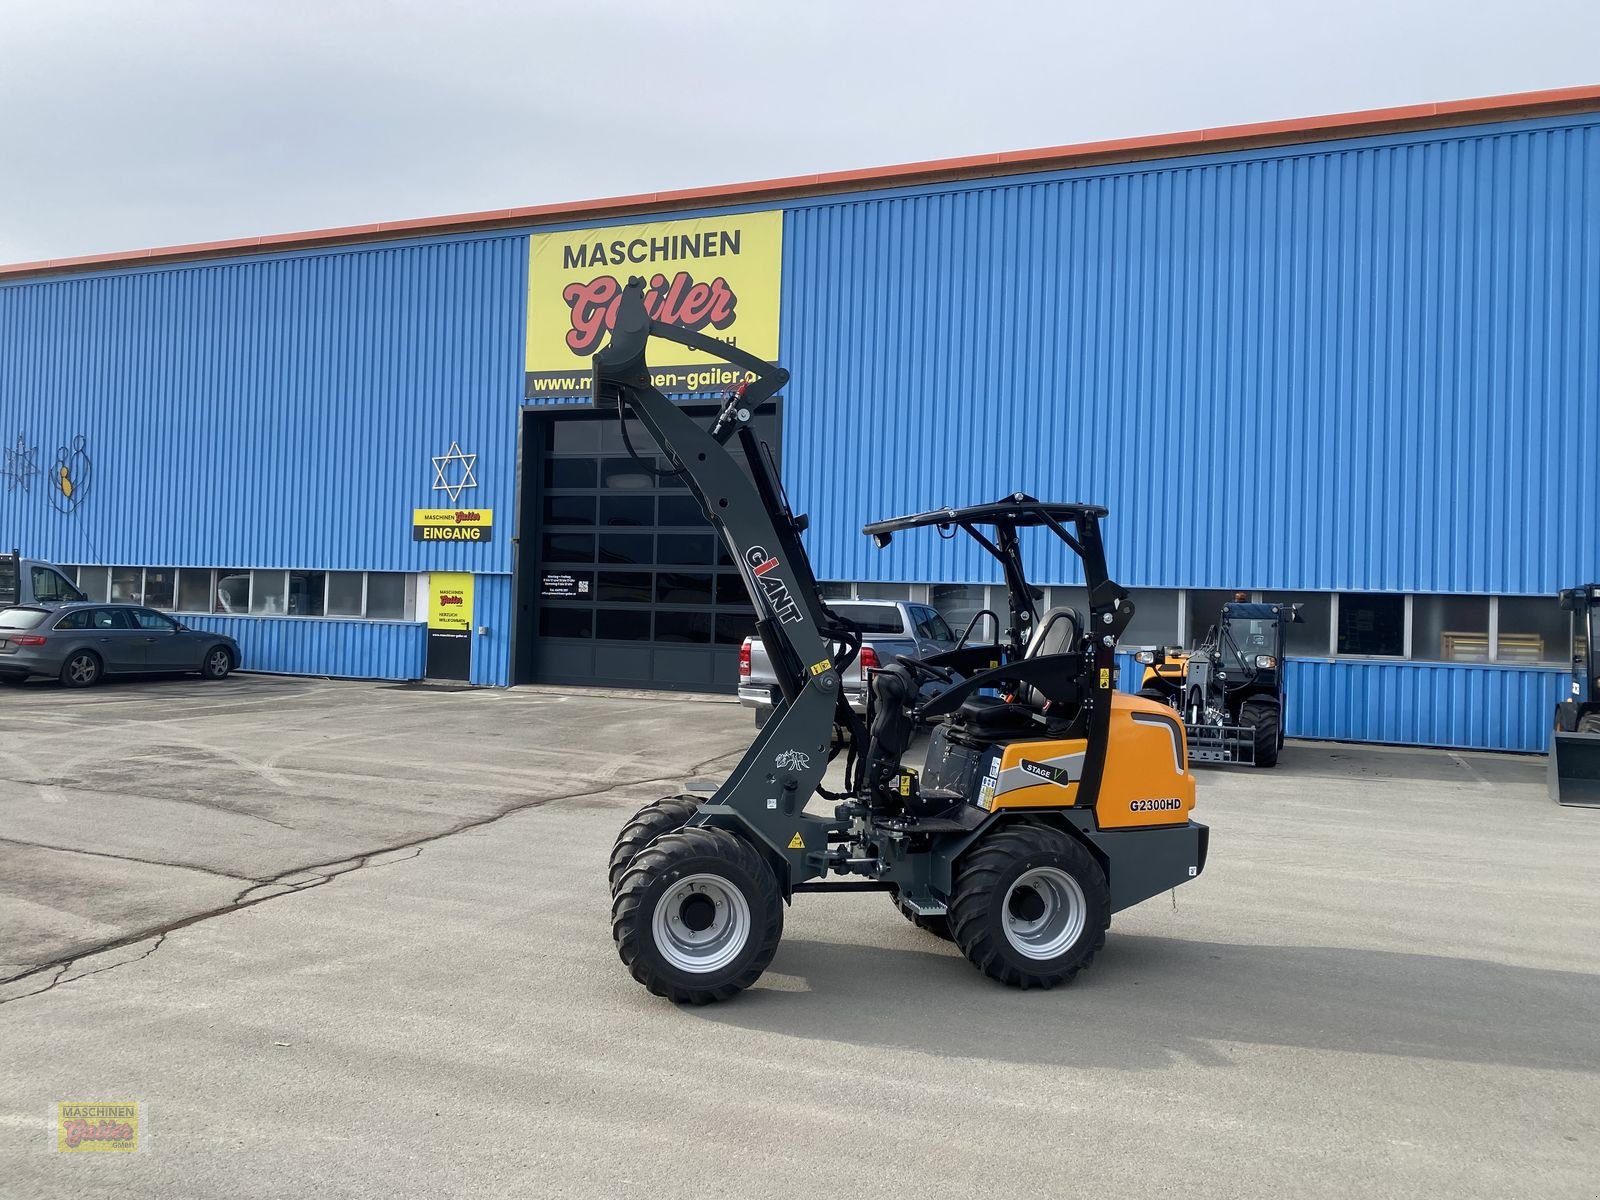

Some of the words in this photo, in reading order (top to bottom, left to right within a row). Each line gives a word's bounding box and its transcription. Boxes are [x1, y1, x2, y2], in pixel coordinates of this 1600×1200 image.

[563, 229, 741, 269] MASCHINEN
[423, 527, 480, 540] EINGANG
[745, 545, 804, 624] GIANT
[1026, 764, 1051, 778] STAGE
[1130, 798, 1181, 811] G2300HD
